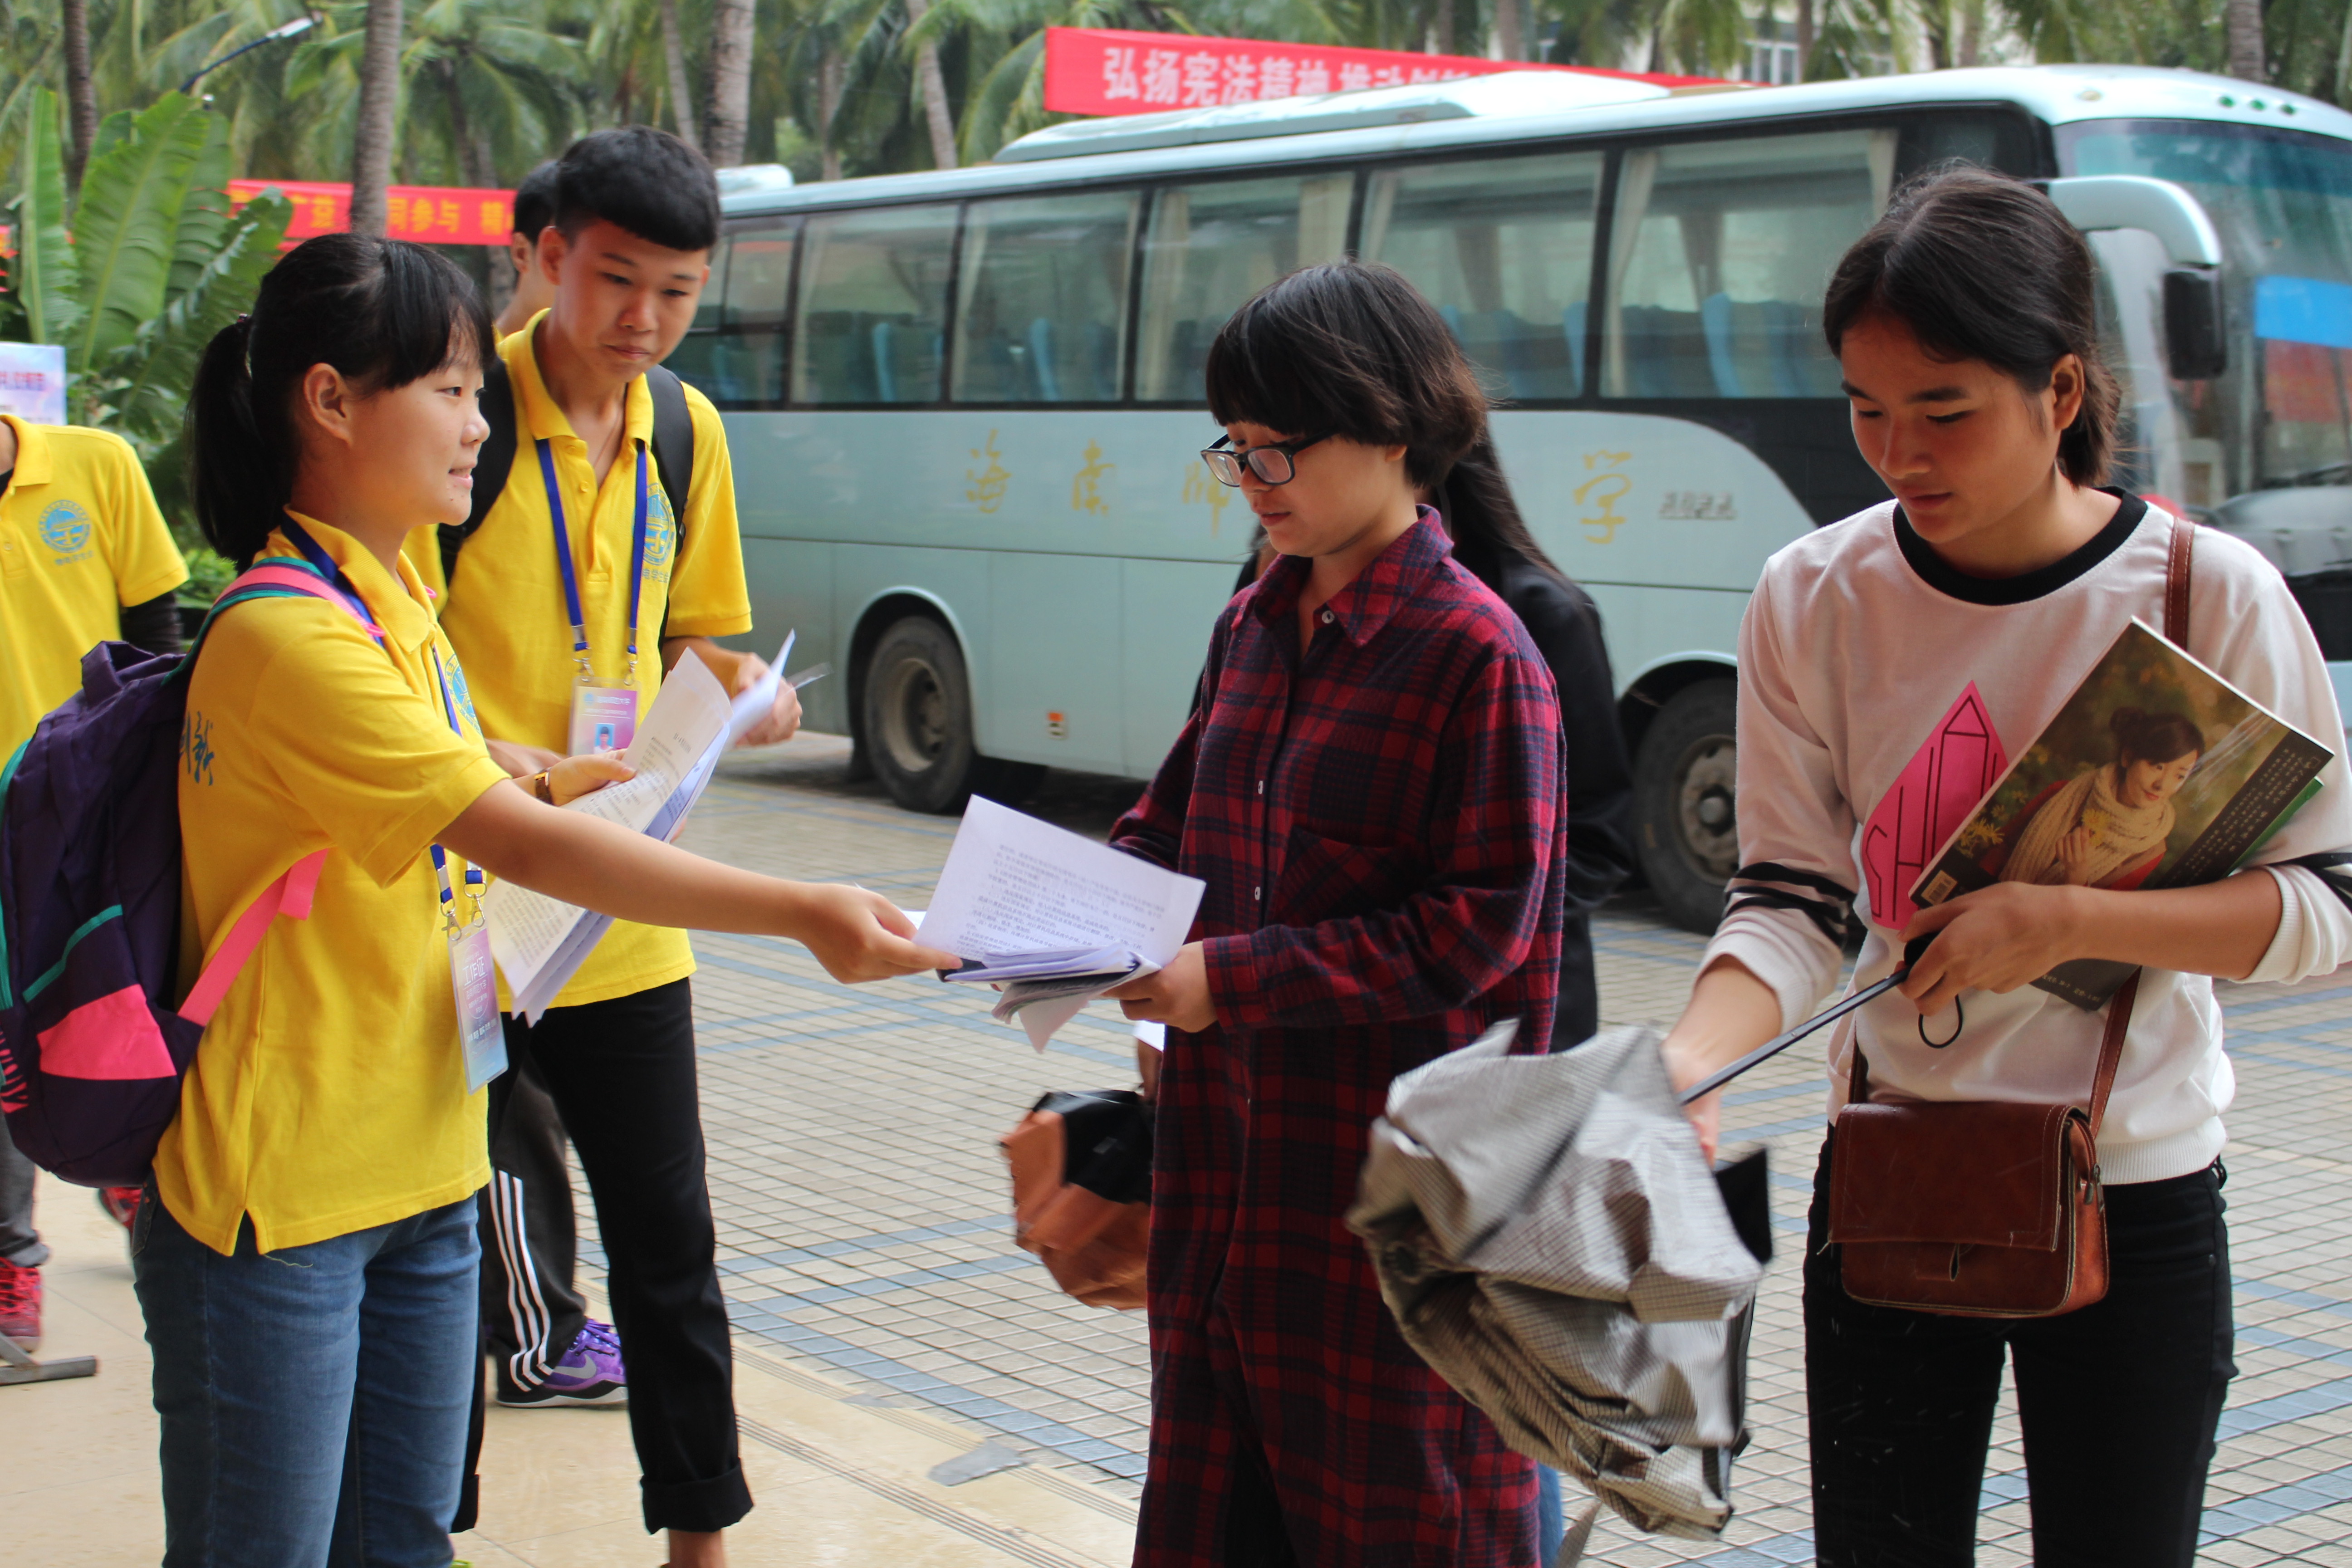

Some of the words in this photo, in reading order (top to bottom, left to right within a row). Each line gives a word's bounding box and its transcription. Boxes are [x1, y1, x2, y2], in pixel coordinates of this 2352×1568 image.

[1103, 48, 1329, 105] 弘扬宪法精神
[462, 956, 486, 986] 工作证
